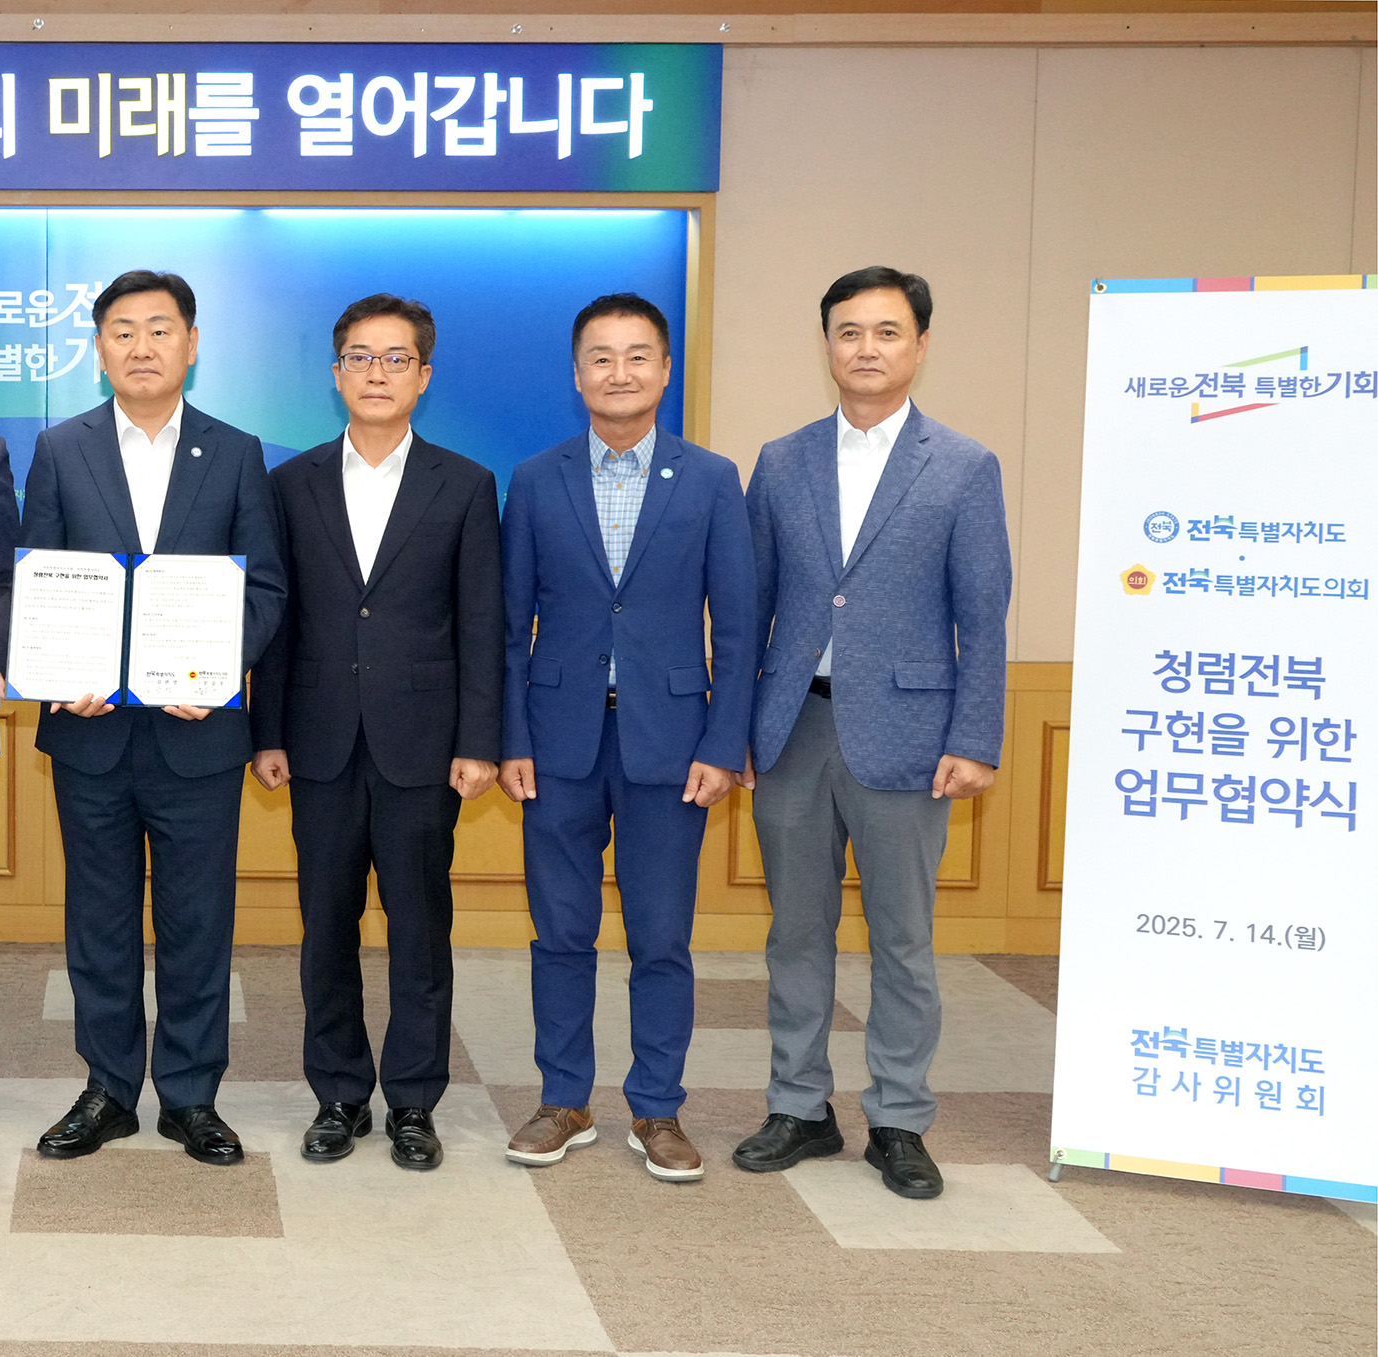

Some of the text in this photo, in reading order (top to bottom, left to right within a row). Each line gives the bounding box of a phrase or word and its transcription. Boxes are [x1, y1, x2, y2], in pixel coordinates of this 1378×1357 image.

[48, 71, 260, 159] 미래를
[286, 71, 653, 160] 열어갑니다
[1187, 515, 1346, 544] 전북특별자치도
[1128, 576, 1147, 585] 의회
[1163, 568, 1368, 600] 전북특별자치도의회
[1153, 650, 1325, 700] 청렴전북
[1122, 710, 1357, 762] 구현을 위한
[1115, 769, 1356, 832] 업무협약식
[1137, 914, 1325, 951] 2025. 7. 14.(월)
[1131, 1026, 1324, 1075] 전북특별자치도
